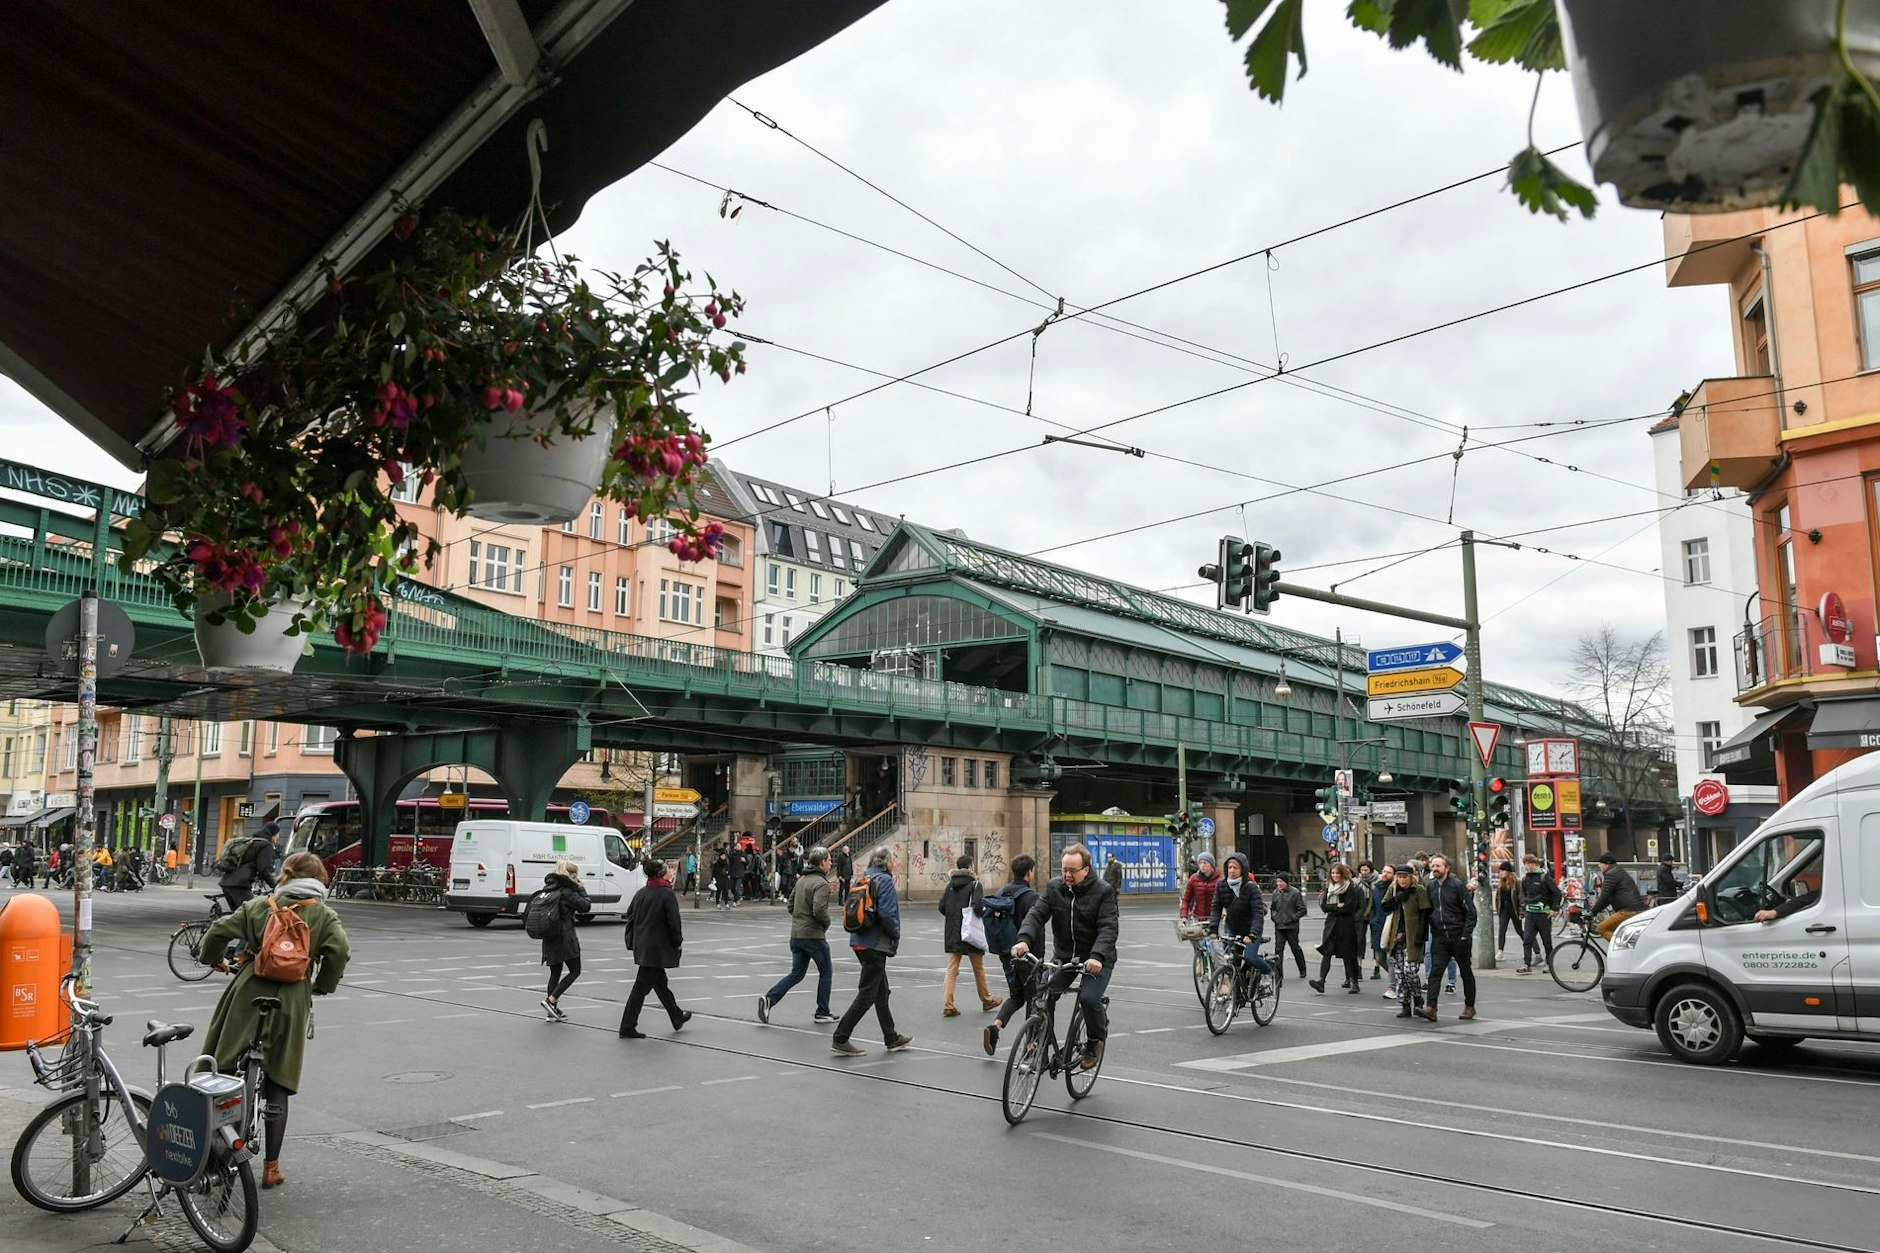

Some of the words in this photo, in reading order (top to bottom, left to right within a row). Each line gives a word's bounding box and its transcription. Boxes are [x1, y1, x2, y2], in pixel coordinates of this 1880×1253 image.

[1375, 676, 1431, 690] Friedrichshain
[1396, 699, 1441, 712] Schönefeld
[791, 802, 828, 812] Eberswalder
[1742, 950, 1817, 961] enterprise.de
[1743, 961, 1770, 969] 0800
[1772, 961, 1818, 969] 3722826
[15, 987, 34, 1002] BSR
[168, 1122, 197, 1151] DEEZER
